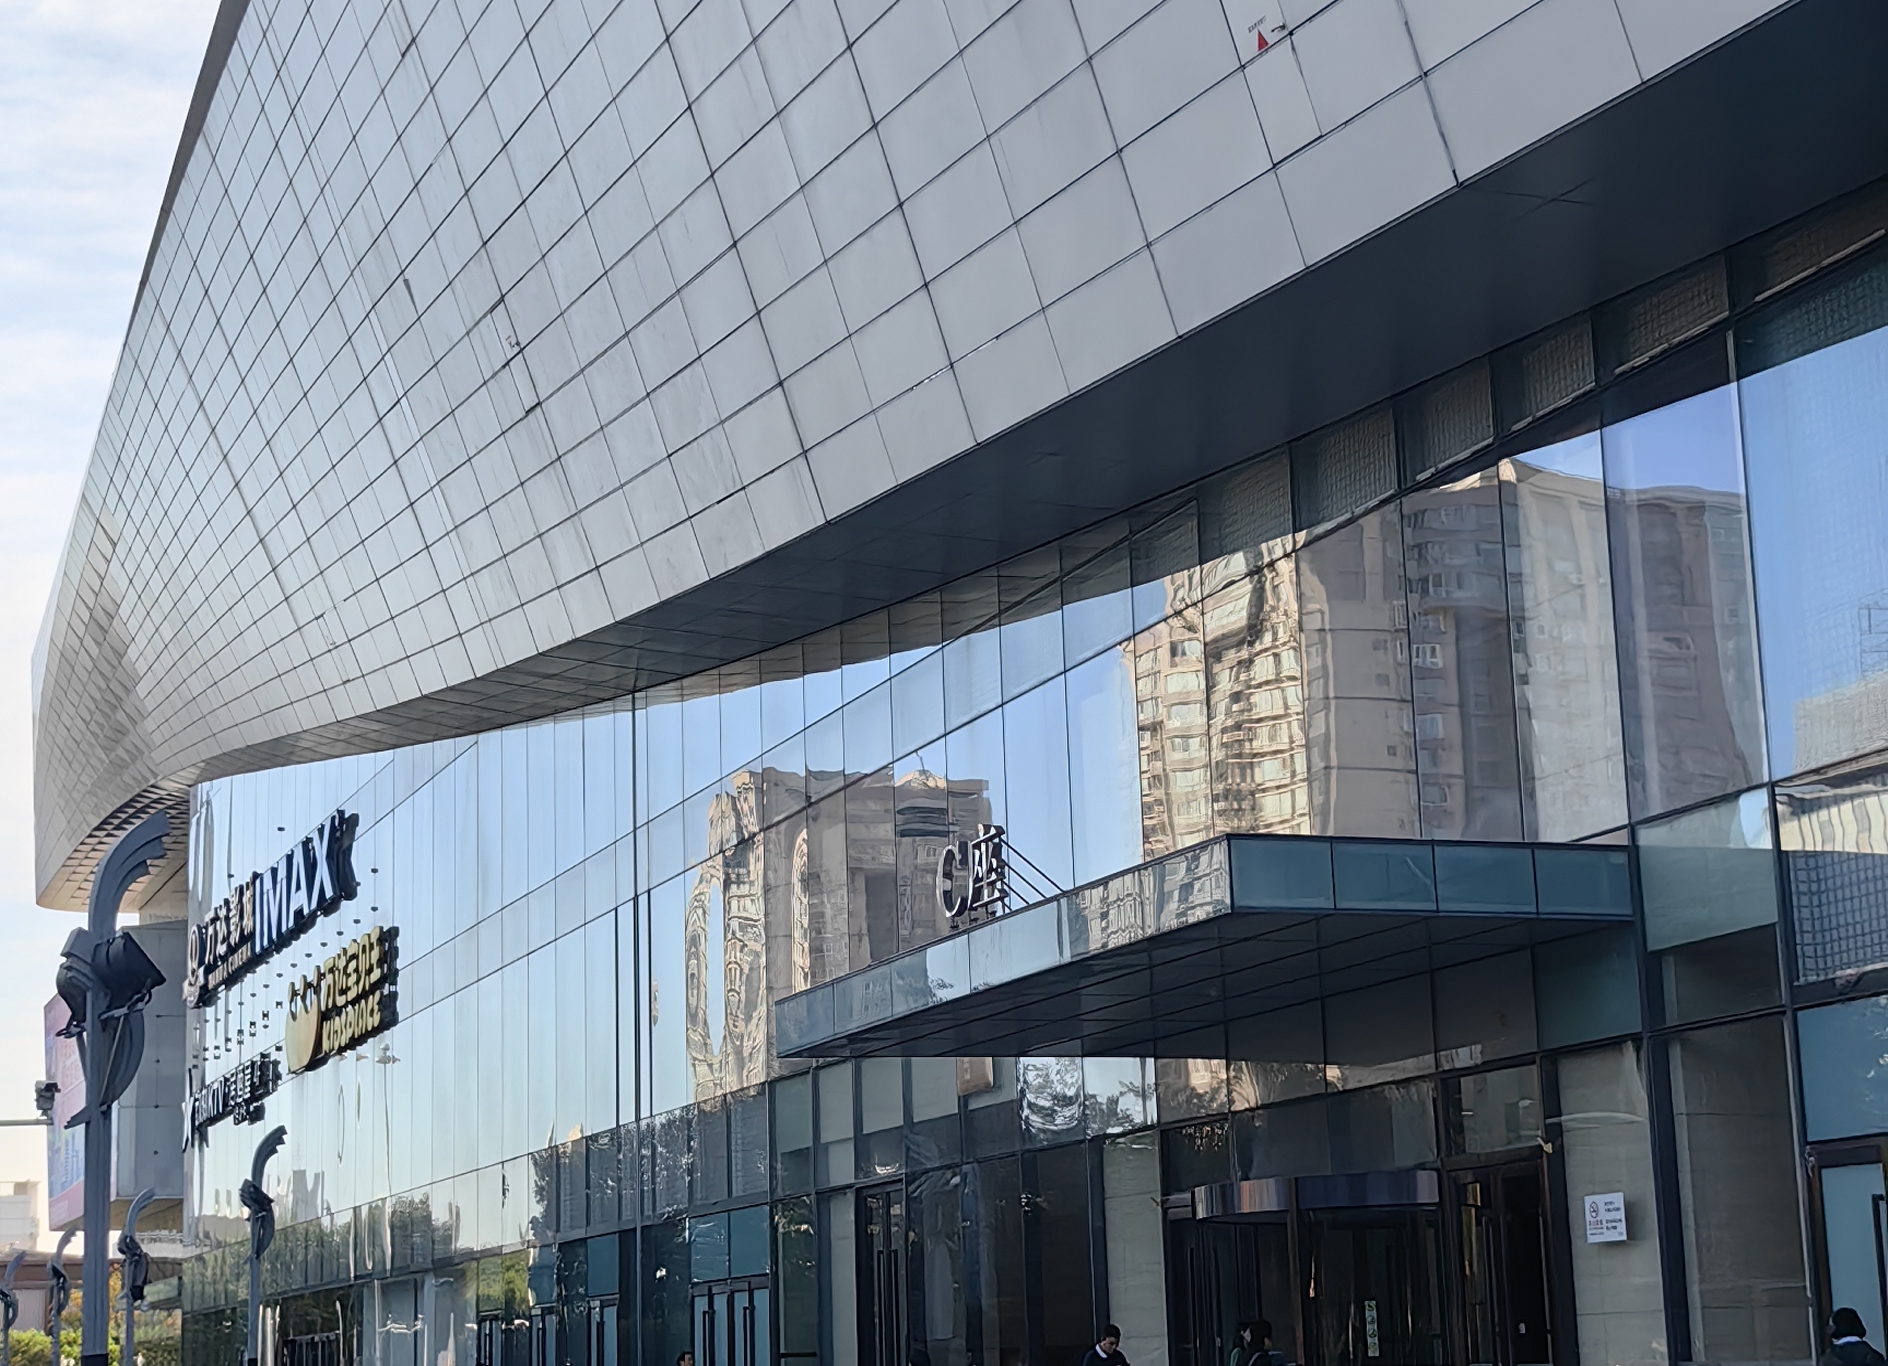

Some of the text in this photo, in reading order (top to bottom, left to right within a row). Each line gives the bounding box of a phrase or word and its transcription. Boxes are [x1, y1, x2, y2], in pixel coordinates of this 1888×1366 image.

[255, 815, 335, 955] IMAX
[936, 823, 1001, 918] C座
[204, 879, 254, 965] 万达影城
[320, 925, 381, 1012] 万达宝贝王
[321, 990, 381, 1054] KIDSPLACE
